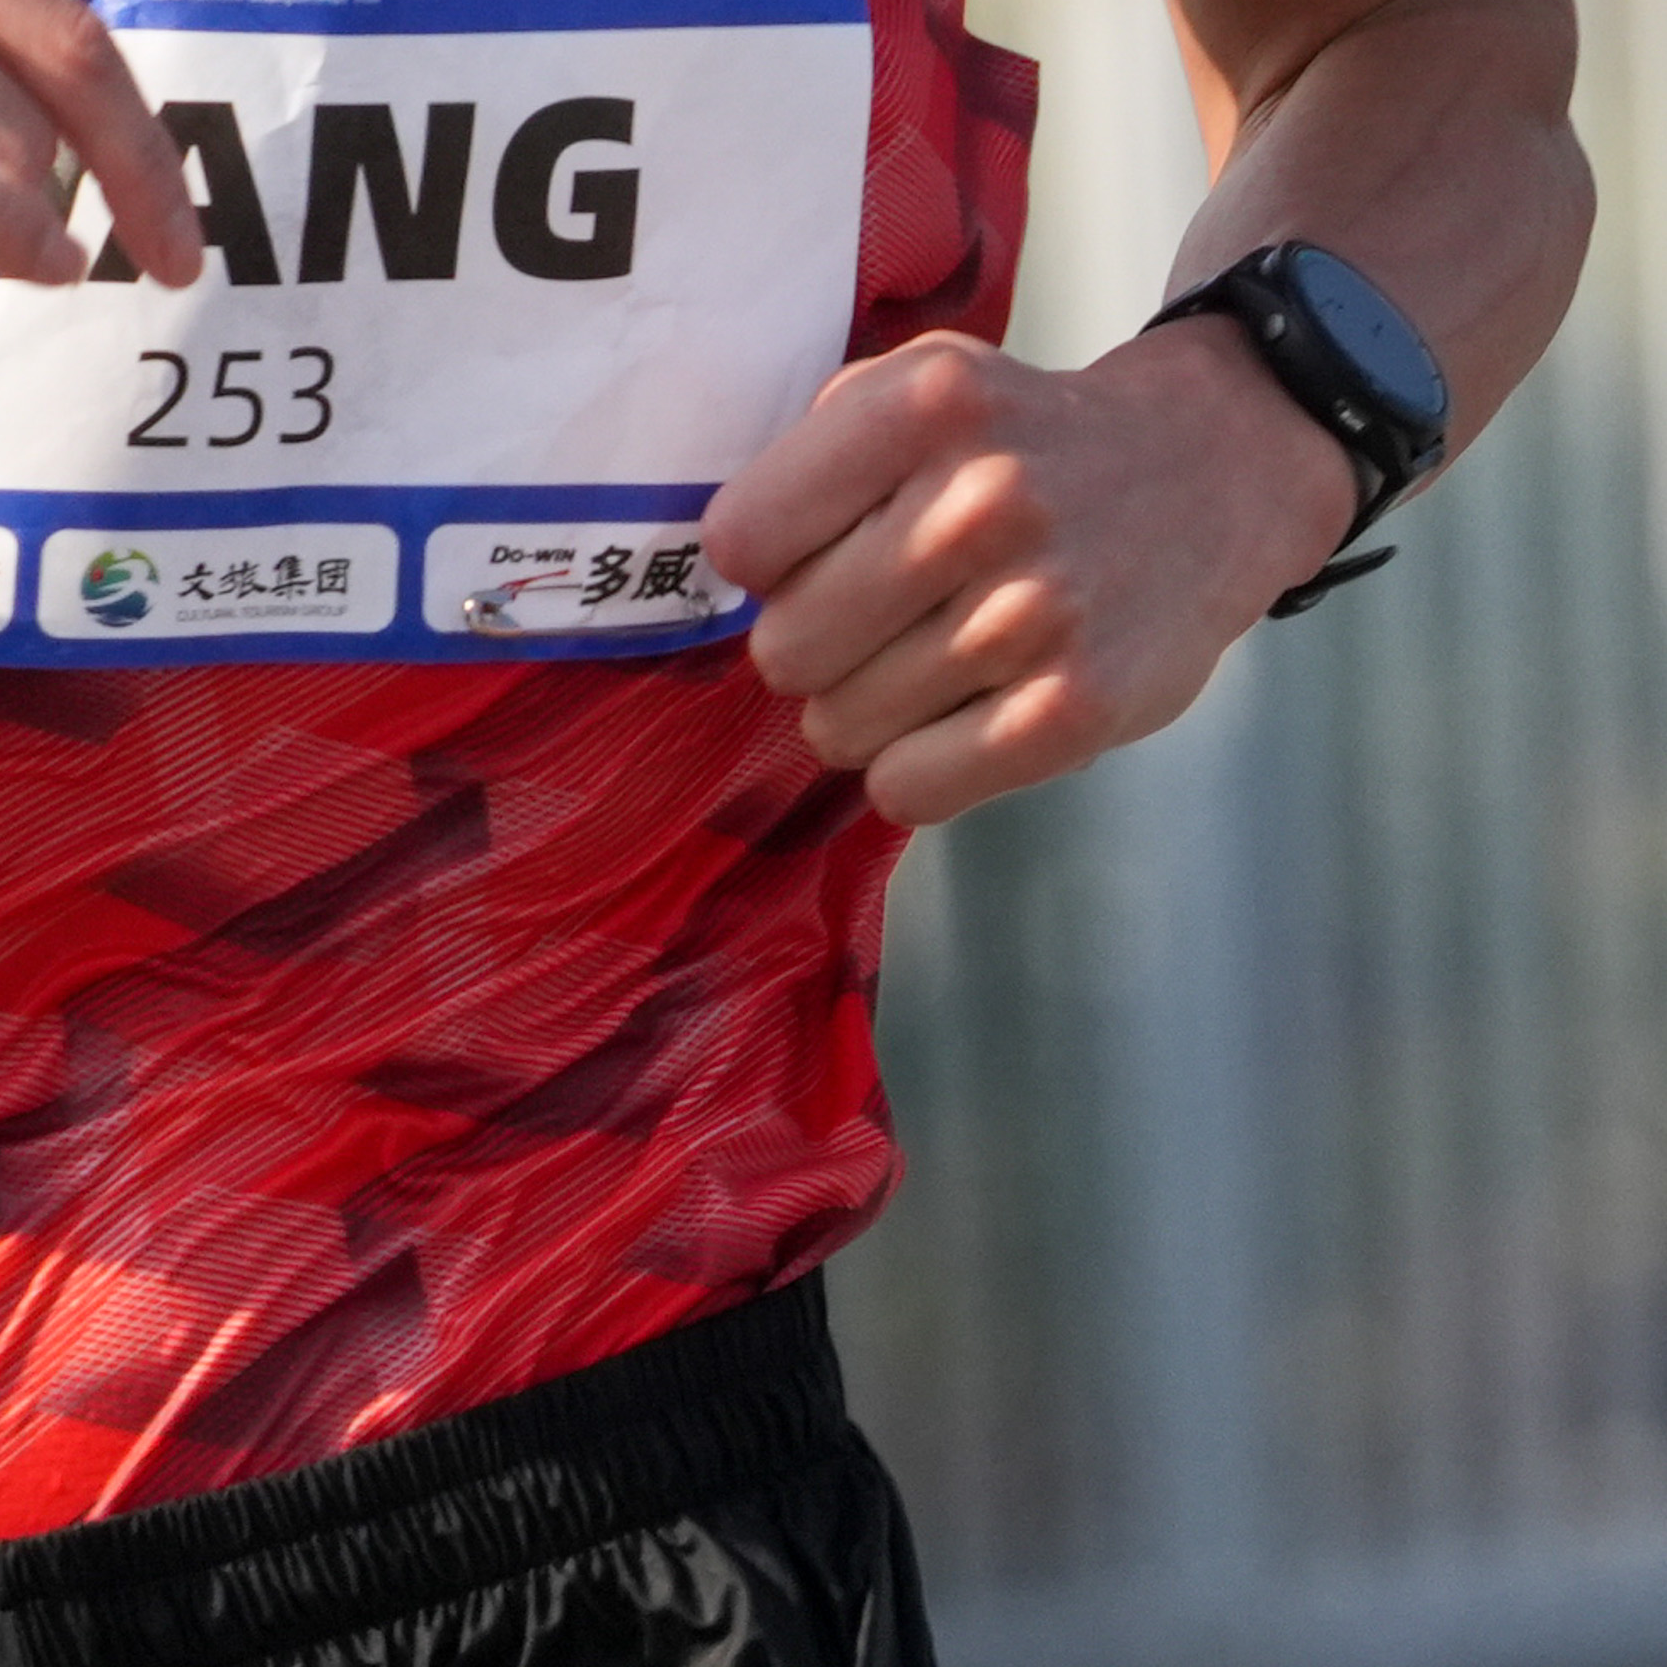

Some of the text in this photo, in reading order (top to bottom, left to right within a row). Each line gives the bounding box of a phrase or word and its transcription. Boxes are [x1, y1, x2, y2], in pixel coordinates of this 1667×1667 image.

[126, 345, 334, 449] 253
[177, 555, 351, 601] 文旅集团
[579, 541, 701, 606] 多威
